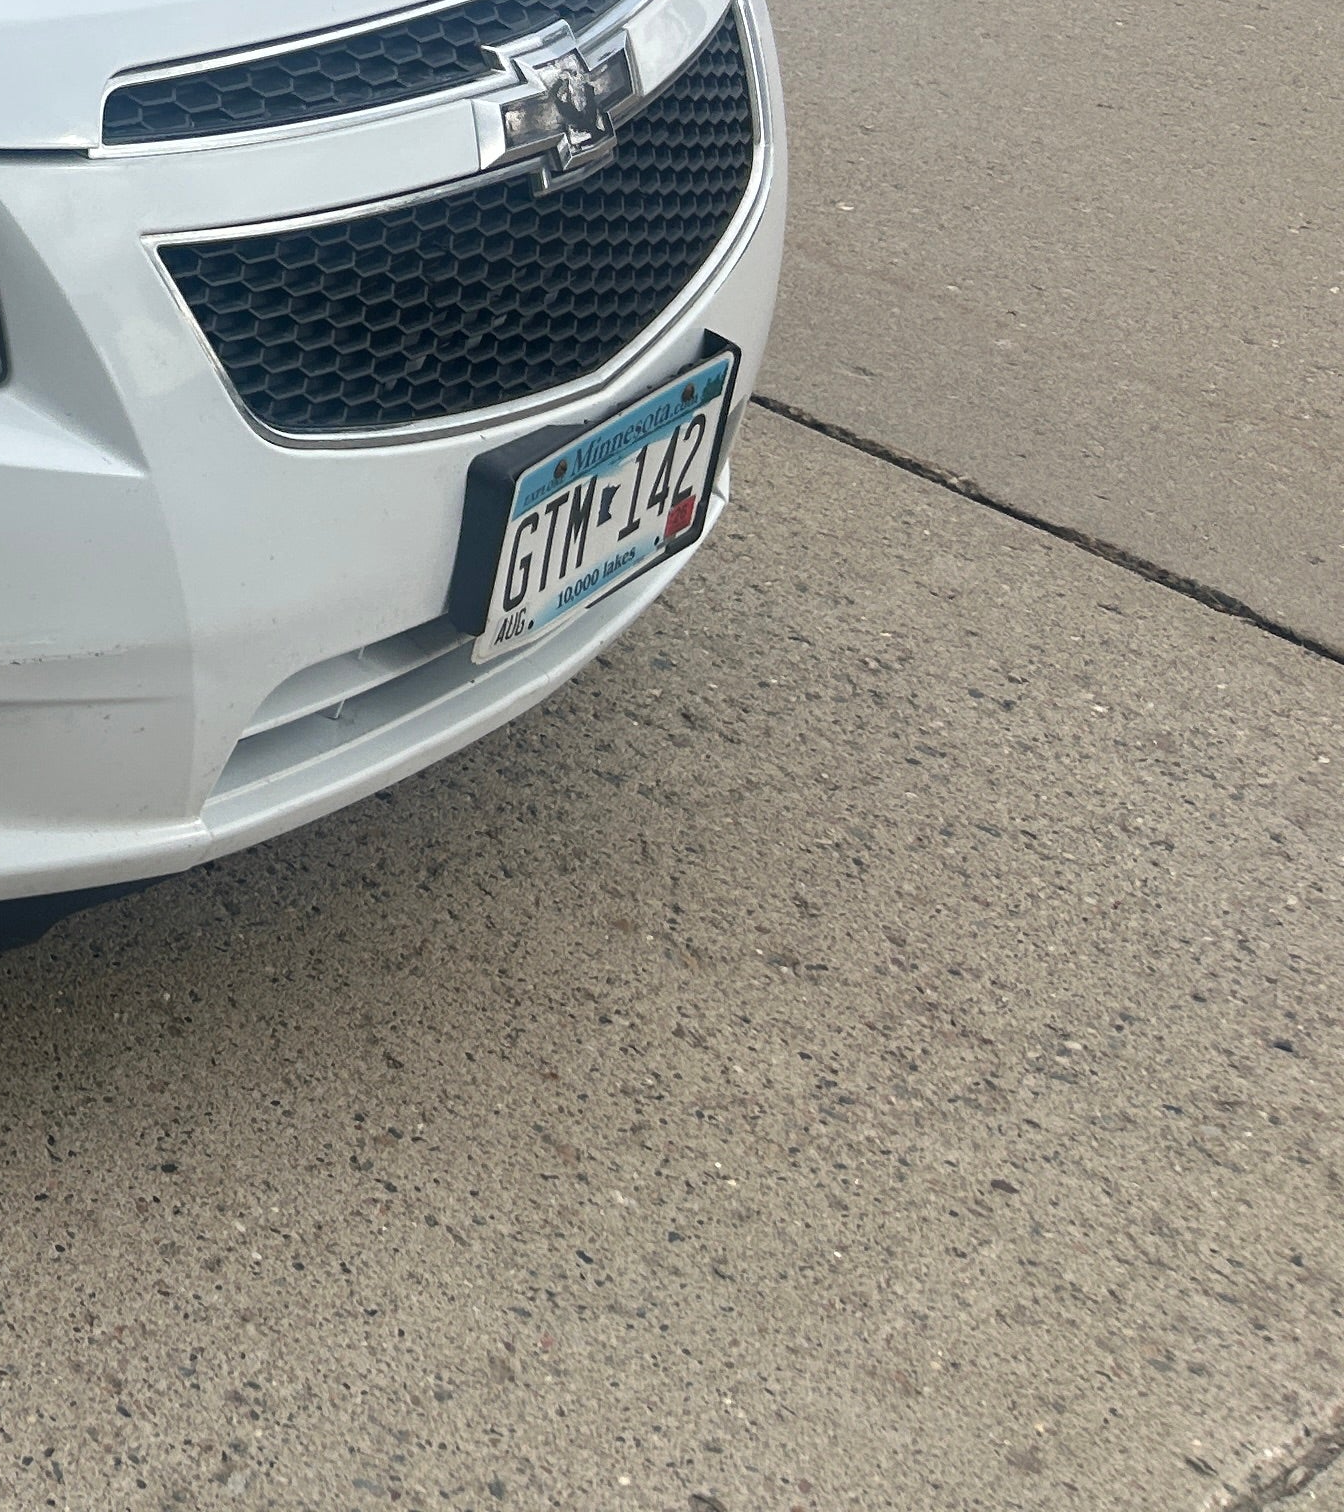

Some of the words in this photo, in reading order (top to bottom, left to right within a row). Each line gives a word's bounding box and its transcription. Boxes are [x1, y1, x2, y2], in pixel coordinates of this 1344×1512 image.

[502, 474, 598, 612] GTM
[617, 413, 706, 542] 142
[558, 568, 600, 609] 10,000
[602, 546, 637, 578] lakes
